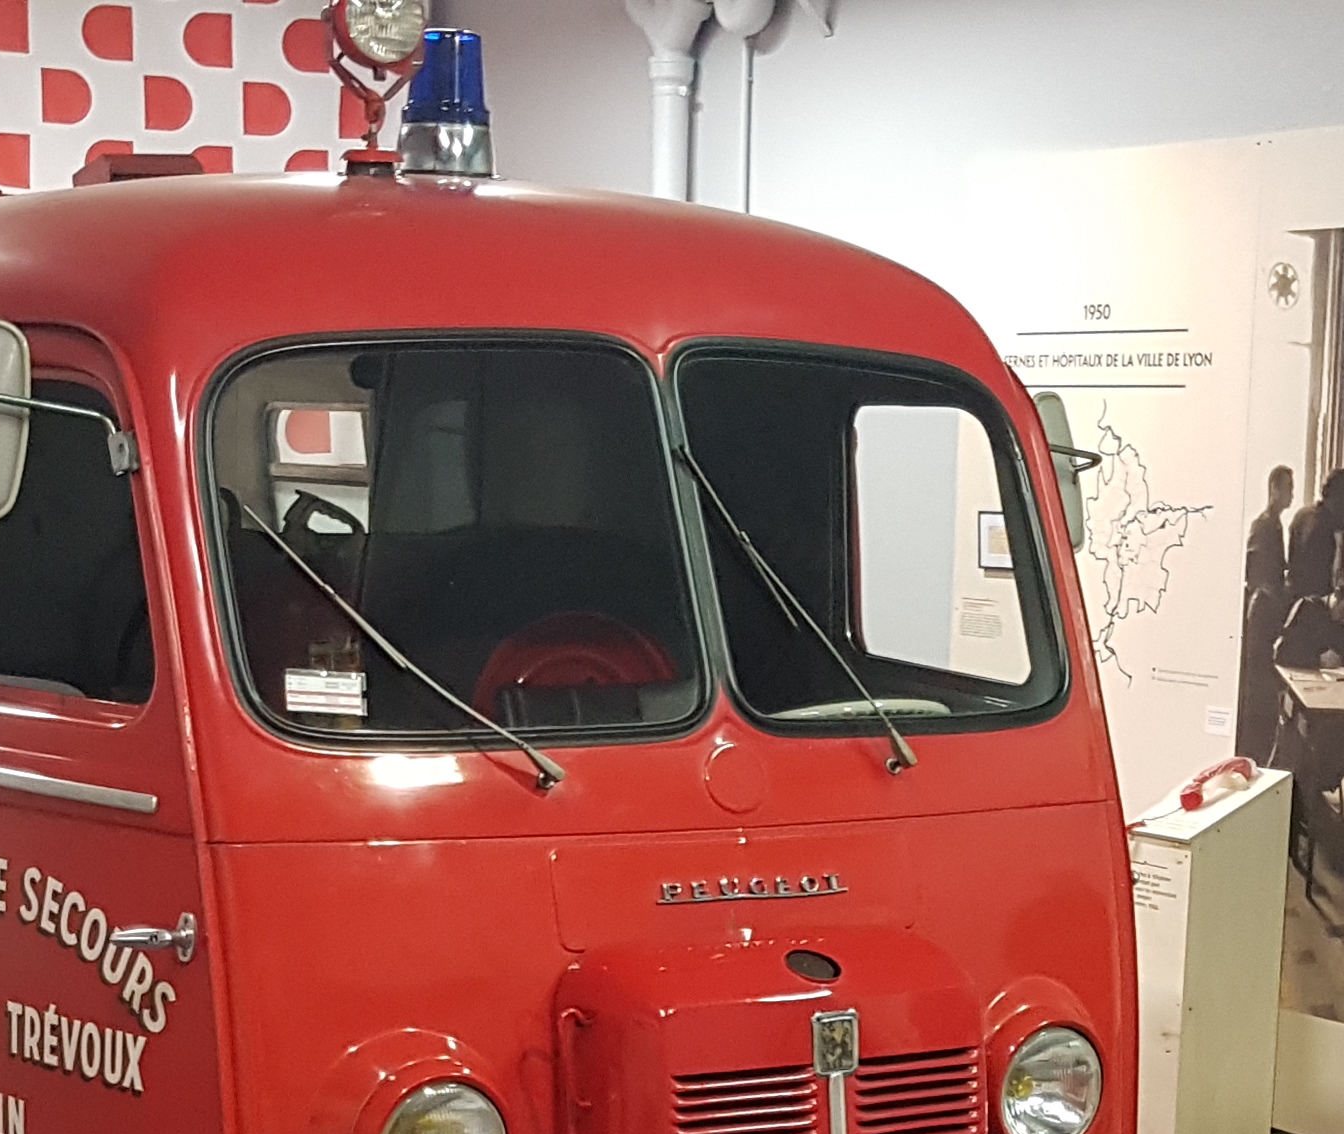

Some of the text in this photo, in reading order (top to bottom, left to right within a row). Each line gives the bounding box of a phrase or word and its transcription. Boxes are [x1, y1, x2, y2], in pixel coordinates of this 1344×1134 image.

[1083, 303, 1112, 321] 1950
[1004, 355, 1035, 368] SERNES
[1039, 354, 1050, 368] ET
[1106, 353, 1119, 368] DE
[1122, 354, 1134, 367] LA
[1137, 353, 1164, 367] VILLE
[1167, 353, 1180, 367] DE
[1183, 352, 1213, 367] LYON
[661, 873, 841, 902] PEUGEOT
[19, 866, 177, 1034] SECOURS
[6, 1001, 147, 1092] TRÉVOUX
